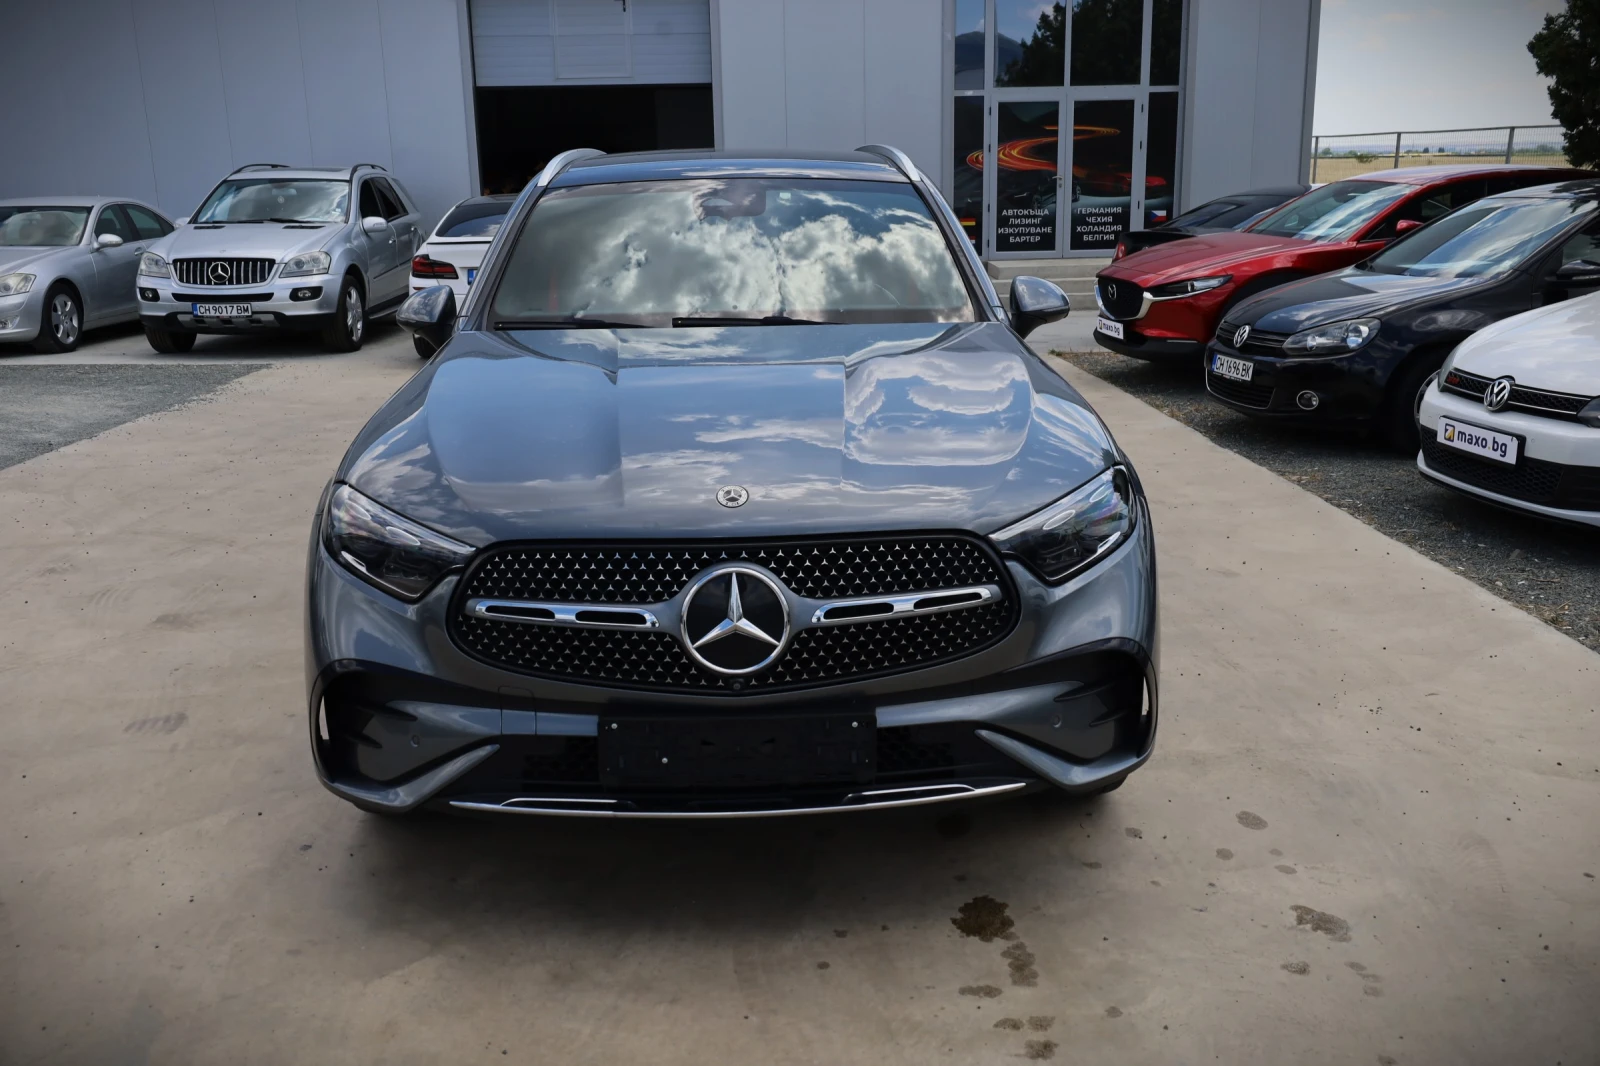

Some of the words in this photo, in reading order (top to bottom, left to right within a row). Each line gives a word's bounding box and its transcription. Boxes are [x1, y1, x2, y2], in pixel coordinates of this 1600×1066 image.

[1001, 208, 1050, 216] АВТОКЪЩА
[1077, 206, 1122, 215] ГЕРМАНИЯ
[1008, 217, 1043, 225] ЛИЗИНГ
[1085, 215, 1113, 223] ЧЕХИЯ
[998, 226, 1053, 234] ИЗКУПУВАНЕ
[1076, 224, 1123, 232] ХОЛАНДИЯ
[1009, 235, 1041, 243] БАРТЕР
[1083, 233, 1115, 242] БЕЛГИЯ
[211, 305, 234, 315] 9017
[1225, 359, 1241, 375] 1696
[1457, 429, 1508, 458] maxo.bg
